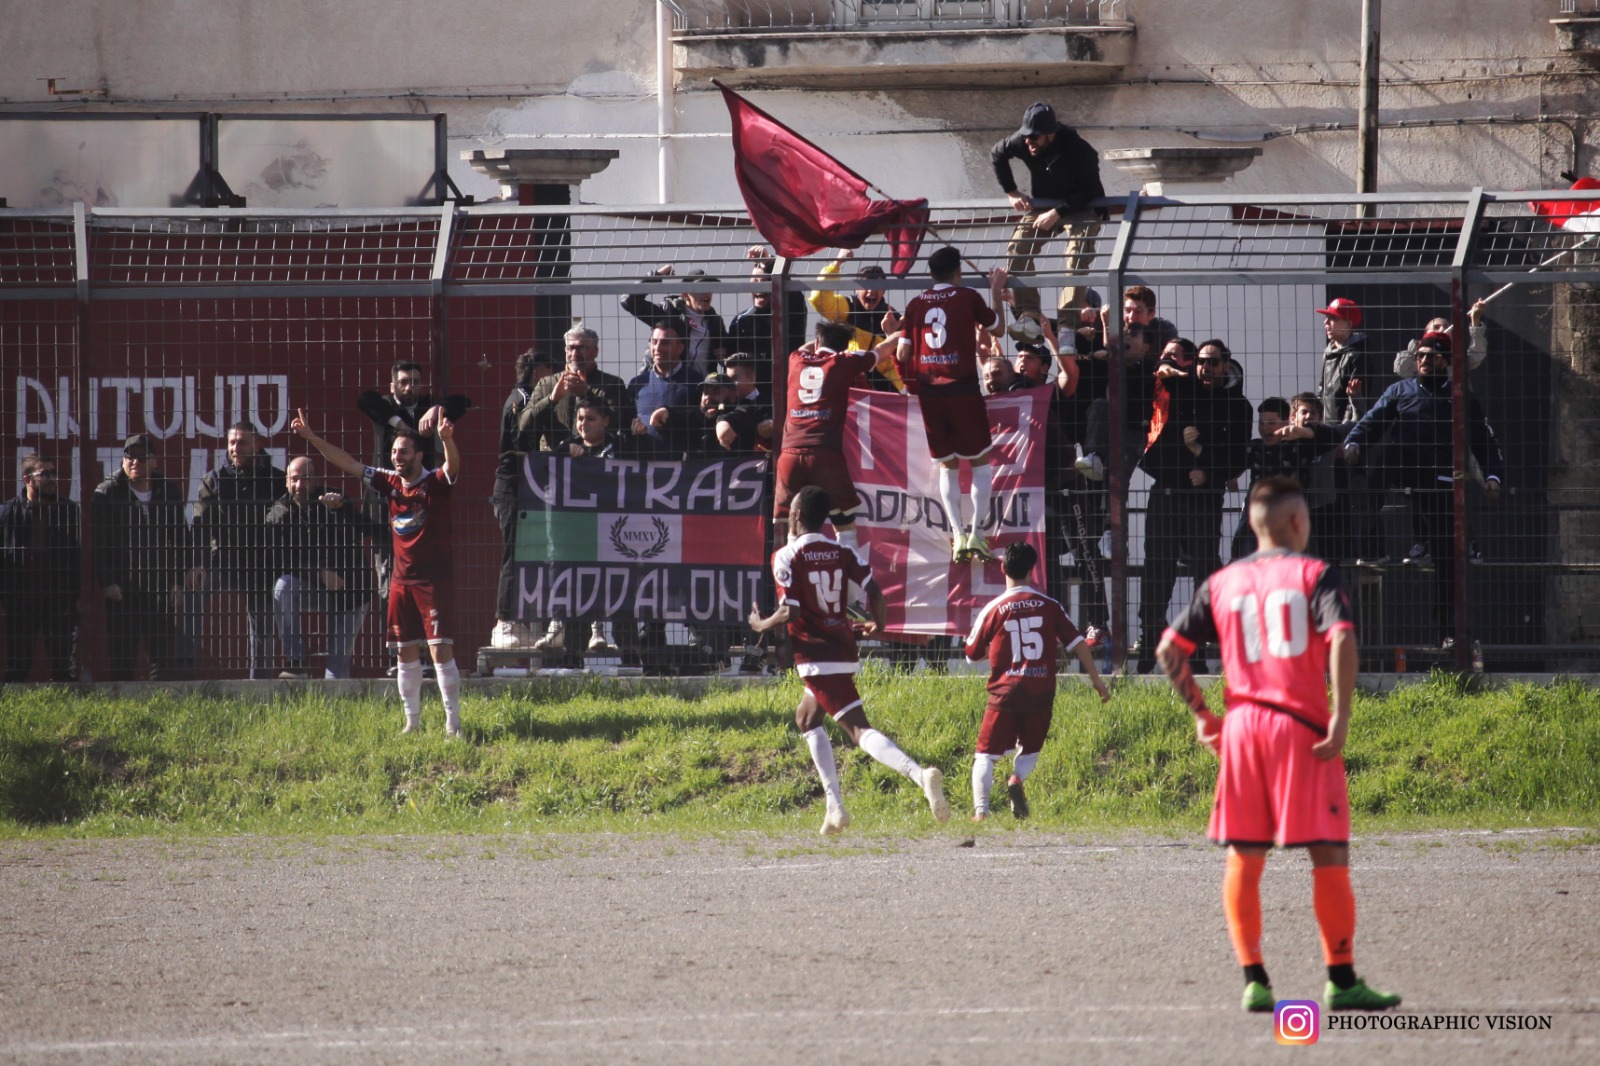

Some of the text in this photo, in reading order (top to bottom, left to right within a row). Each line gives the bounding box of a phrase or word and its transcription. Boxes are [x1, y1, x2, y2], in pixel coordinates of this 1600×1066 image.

[925, 307, 947, 349] 3
[798, 366, 824, 404] 9
[523, 454, 766, 511] ULTRAS
[623, 531, 657, 542] MMXV
[517, 566, 762, 622] MADDALONI
[808, 568, 843, 614] 14
[1003, 616, 1044, 663] 15
[1231, 589, 1308, 663] 10
